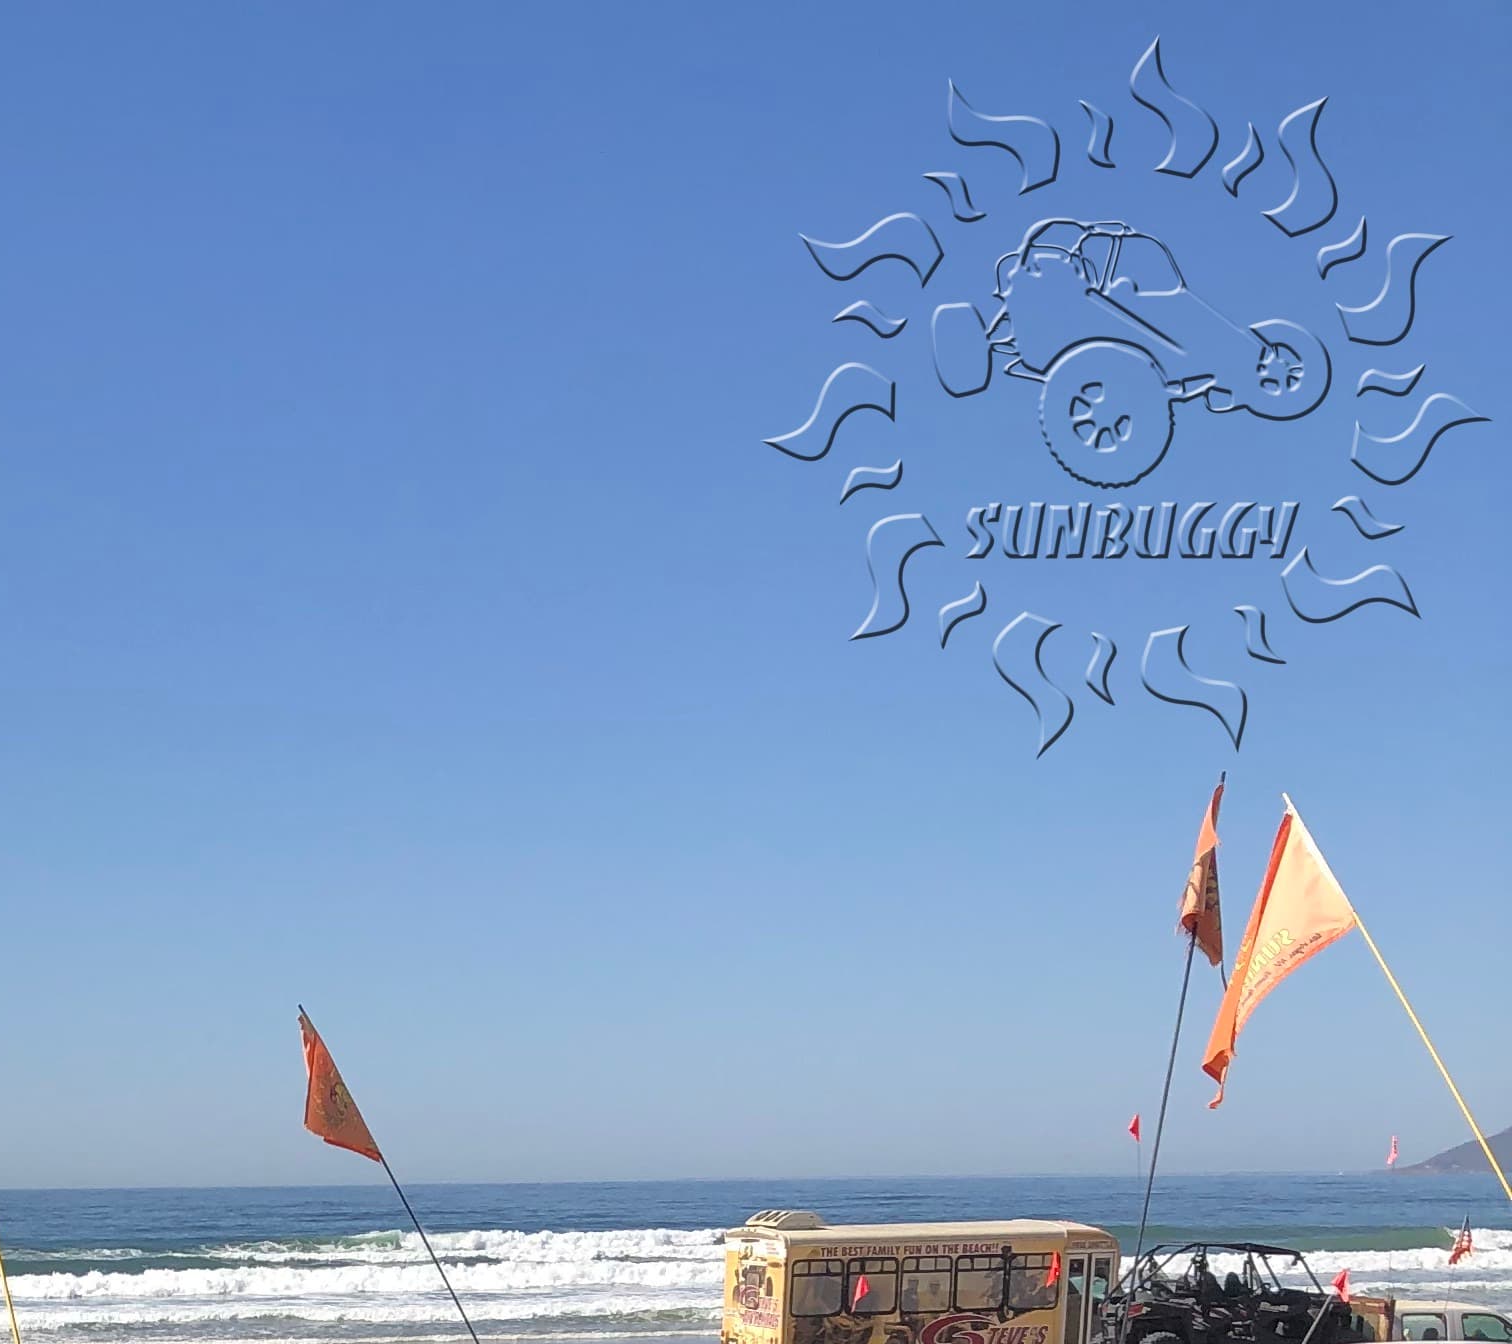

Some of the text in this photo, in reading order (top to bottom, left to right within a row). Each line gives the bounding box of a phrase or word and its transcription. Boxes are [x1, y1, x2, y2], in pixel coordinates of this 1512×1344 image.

[821, 1243, 999, 1257] THE BEST FAMILY FUN ON THE BEACH!!
